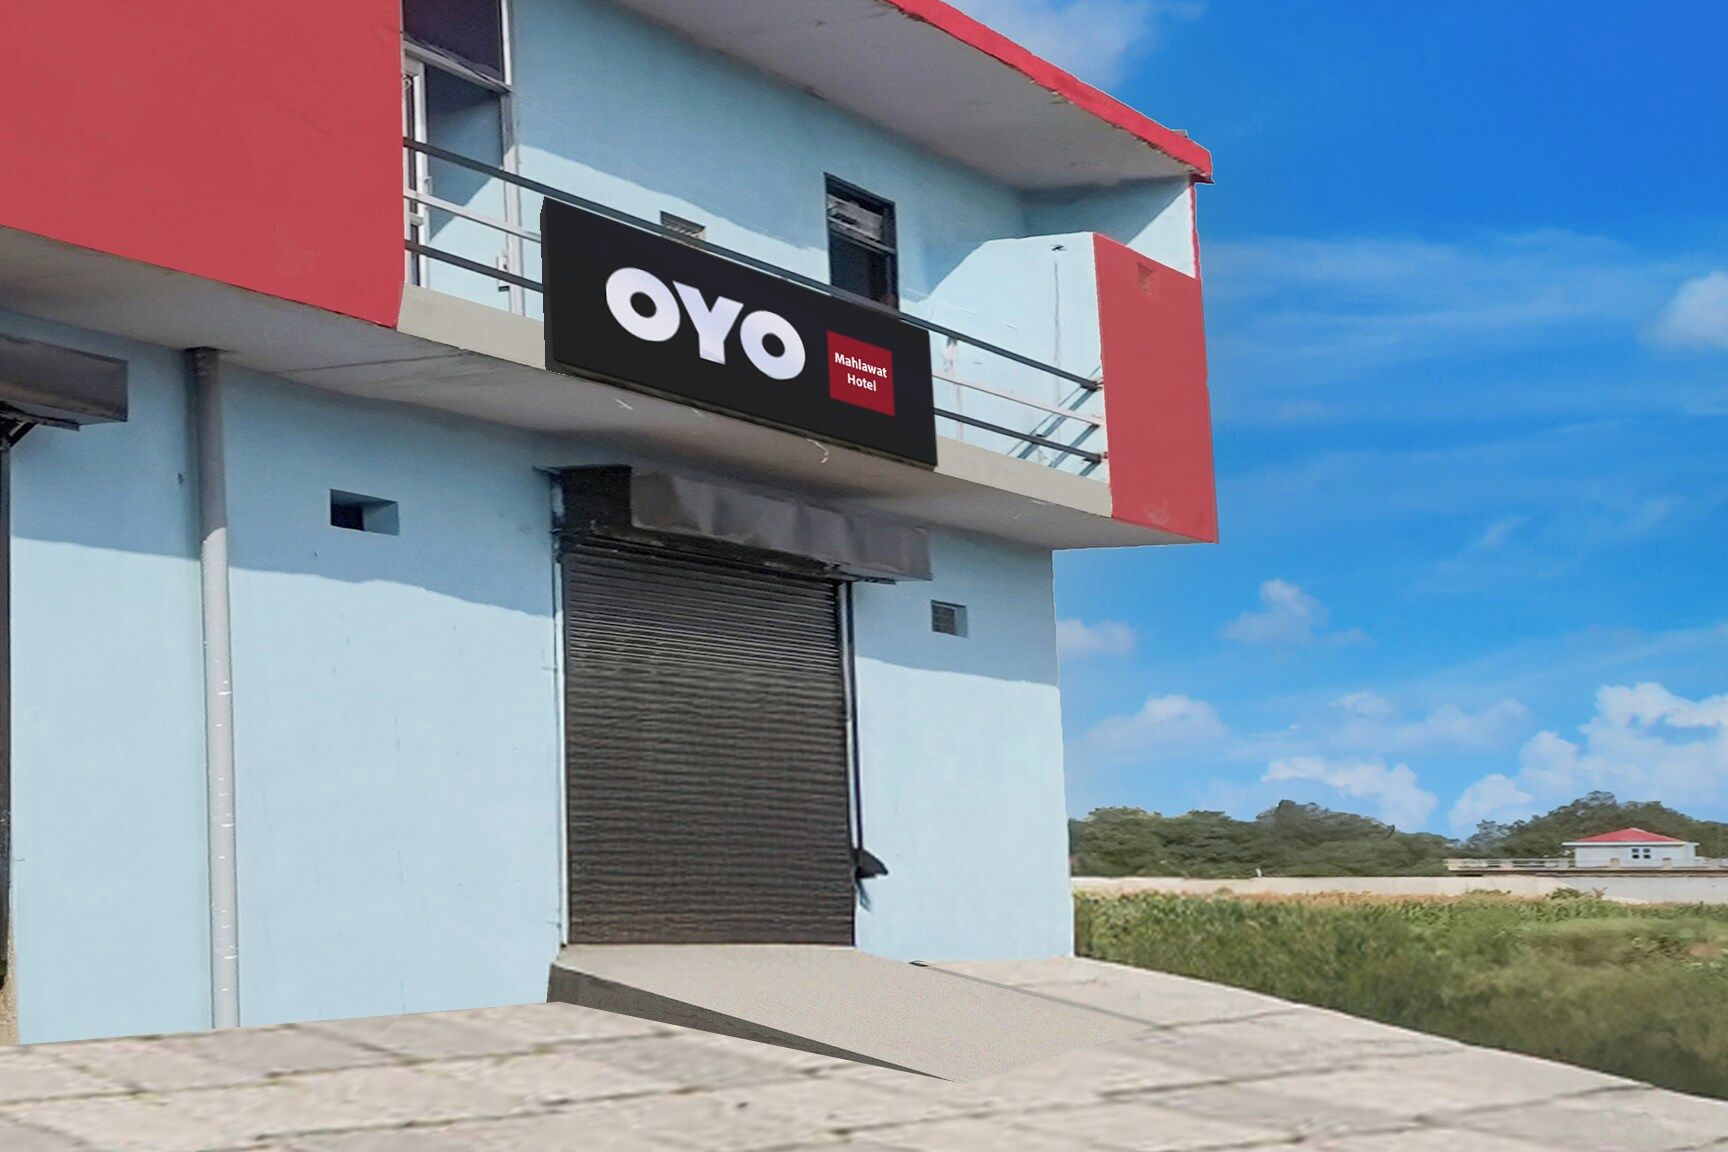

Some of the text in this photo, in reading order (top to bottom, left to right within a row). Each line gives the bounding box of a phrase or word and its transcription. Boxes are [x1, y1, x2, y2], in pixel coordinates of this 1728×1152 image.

[605, 267, 806, 380] OYO
[834, 351, 888, 378] Mahlawat
[847, 372, 877, 392] Hotel
